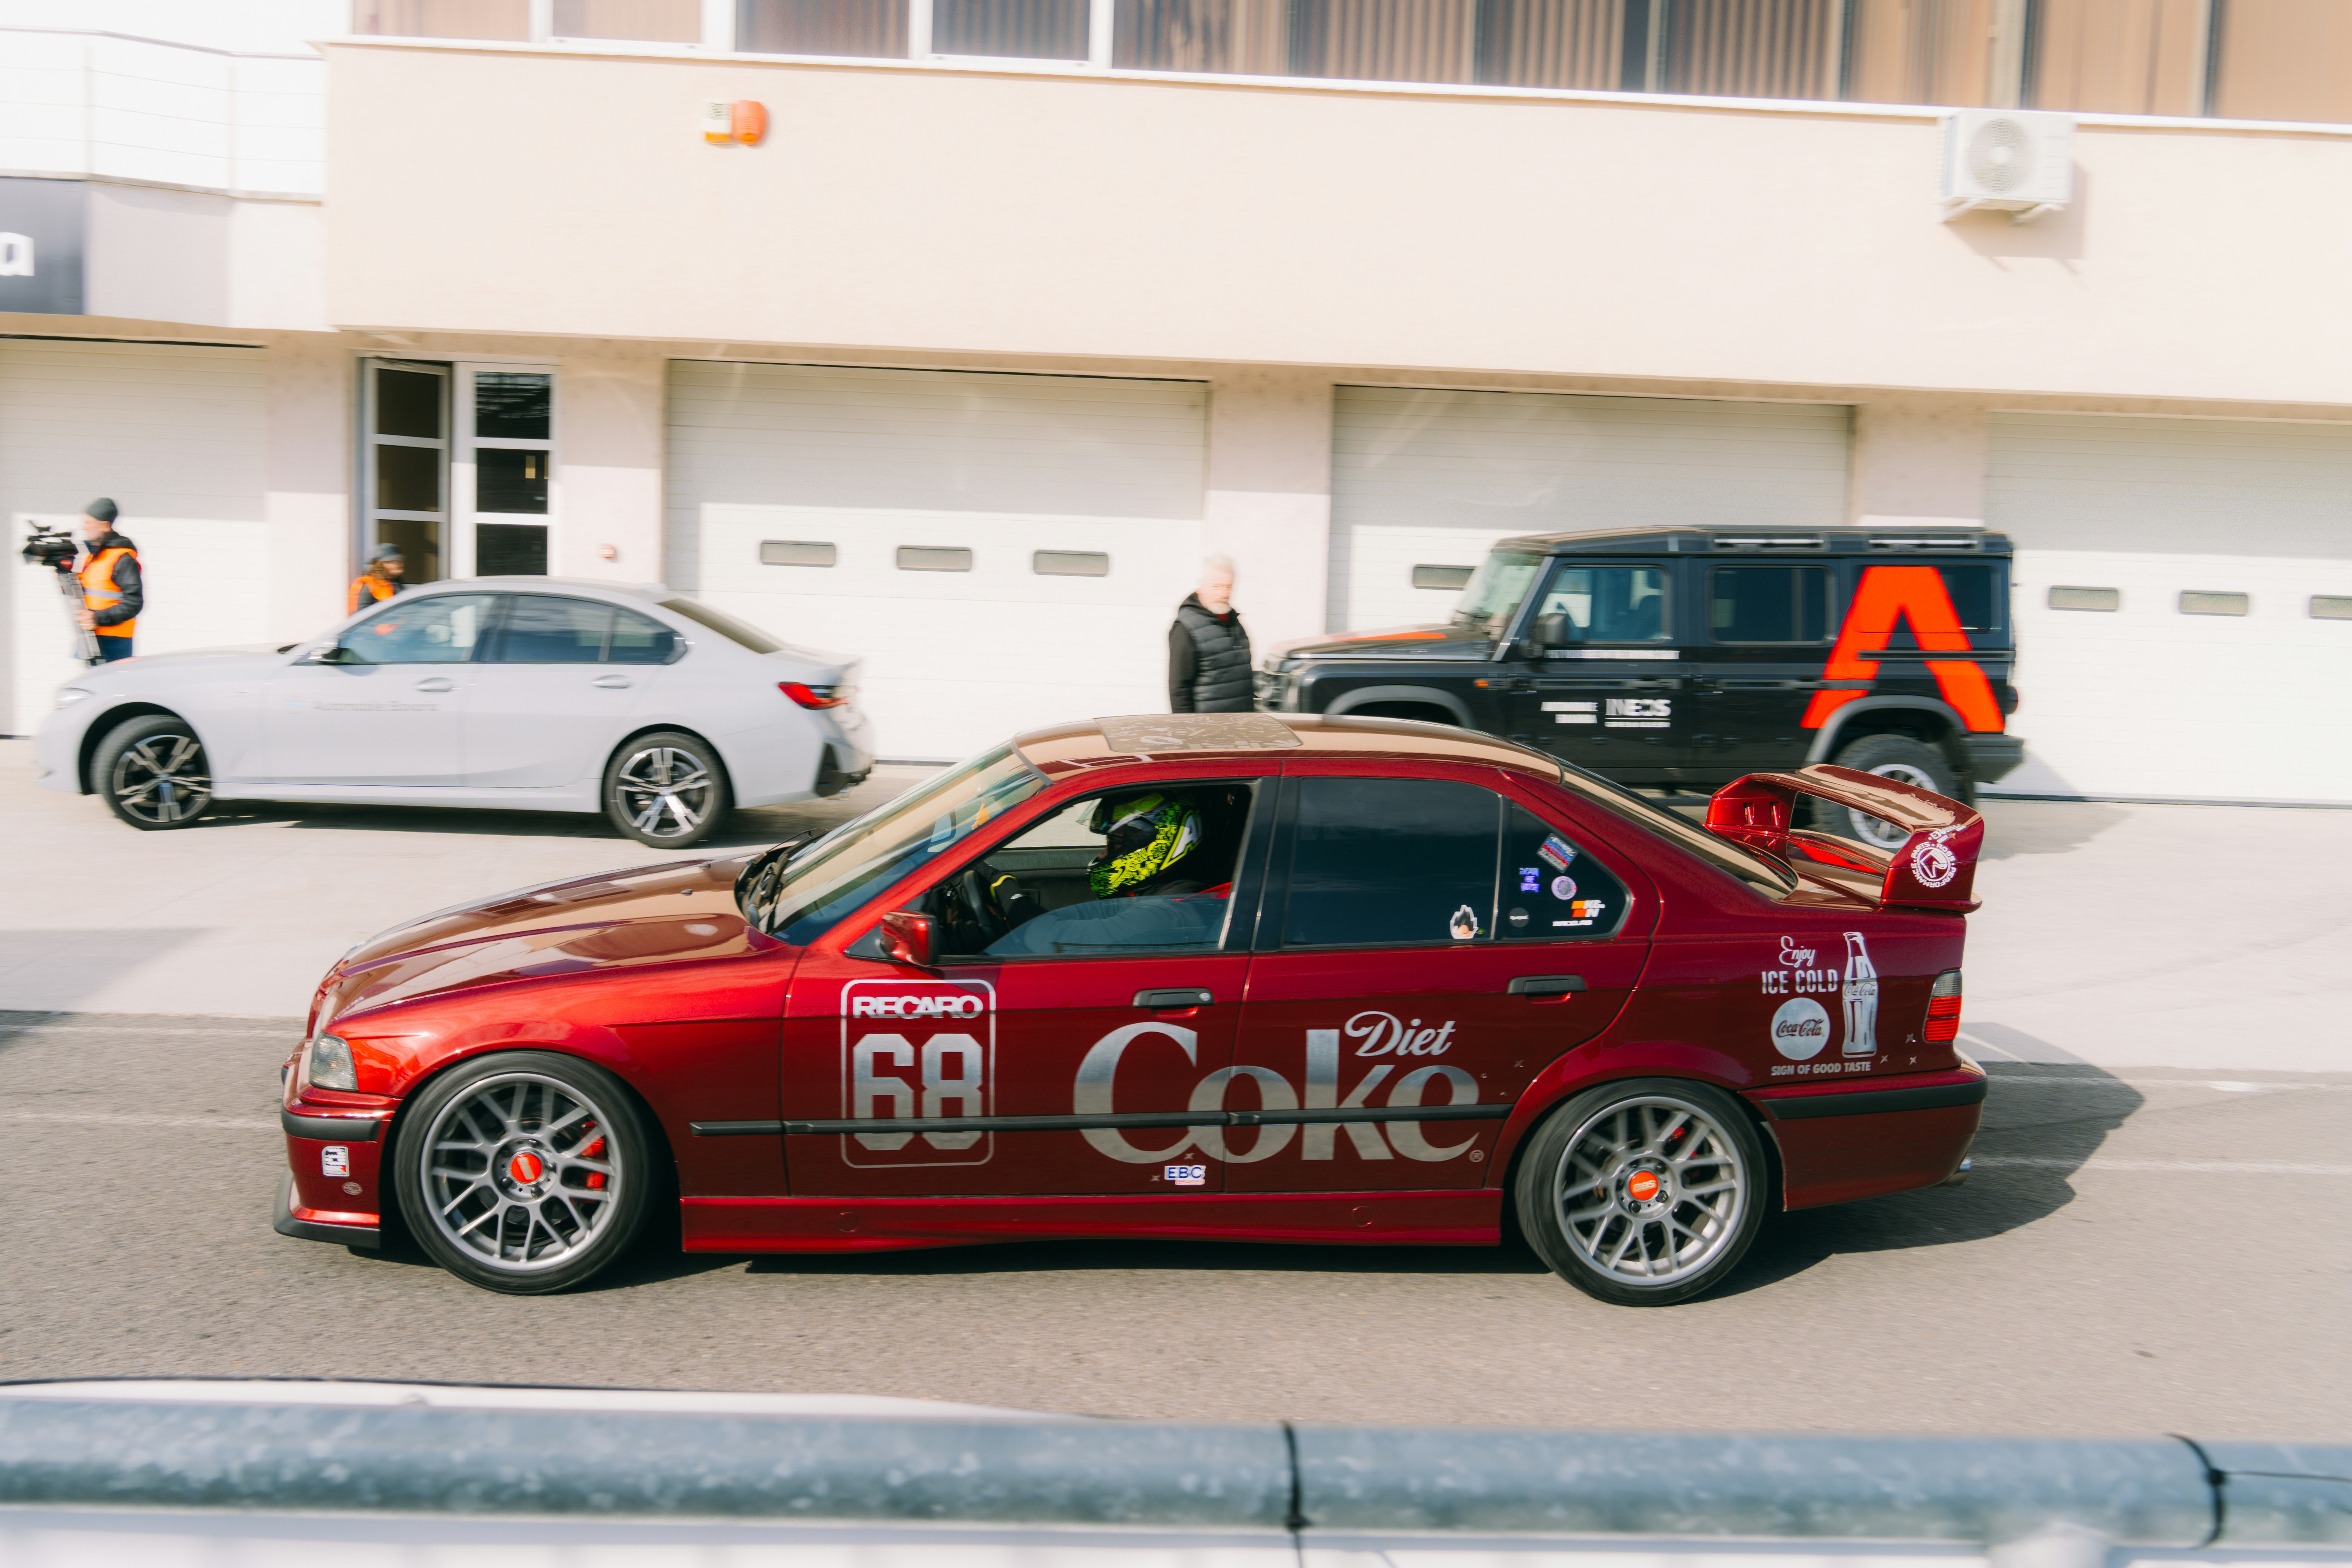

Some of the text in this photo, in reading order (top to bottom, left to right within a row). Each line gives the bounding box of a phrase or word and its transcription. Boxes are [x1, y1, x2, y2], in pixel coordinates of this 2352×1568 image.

[1911, 842, 1930, 858] PARTS
[1936, 843, 1956, 861] ROSS
[1911, 863, 1957, 888] PERFORMANCE
[1779, 936, 1815, 967] Enjoy
[1762, 969, 1838, 994] ICE COLD
[853, 995, 983, 1019] RECARO
[1344, 1011, 1456, 1056] Diet
[1771, 1061, 1871, 1076] SIGN OF GOOD TASTE
[853, 1033, 983, 1150] 68
[1072, 1021, 1480, 1164] Coke
[1168, 1167, 1202, 1179] EBC
